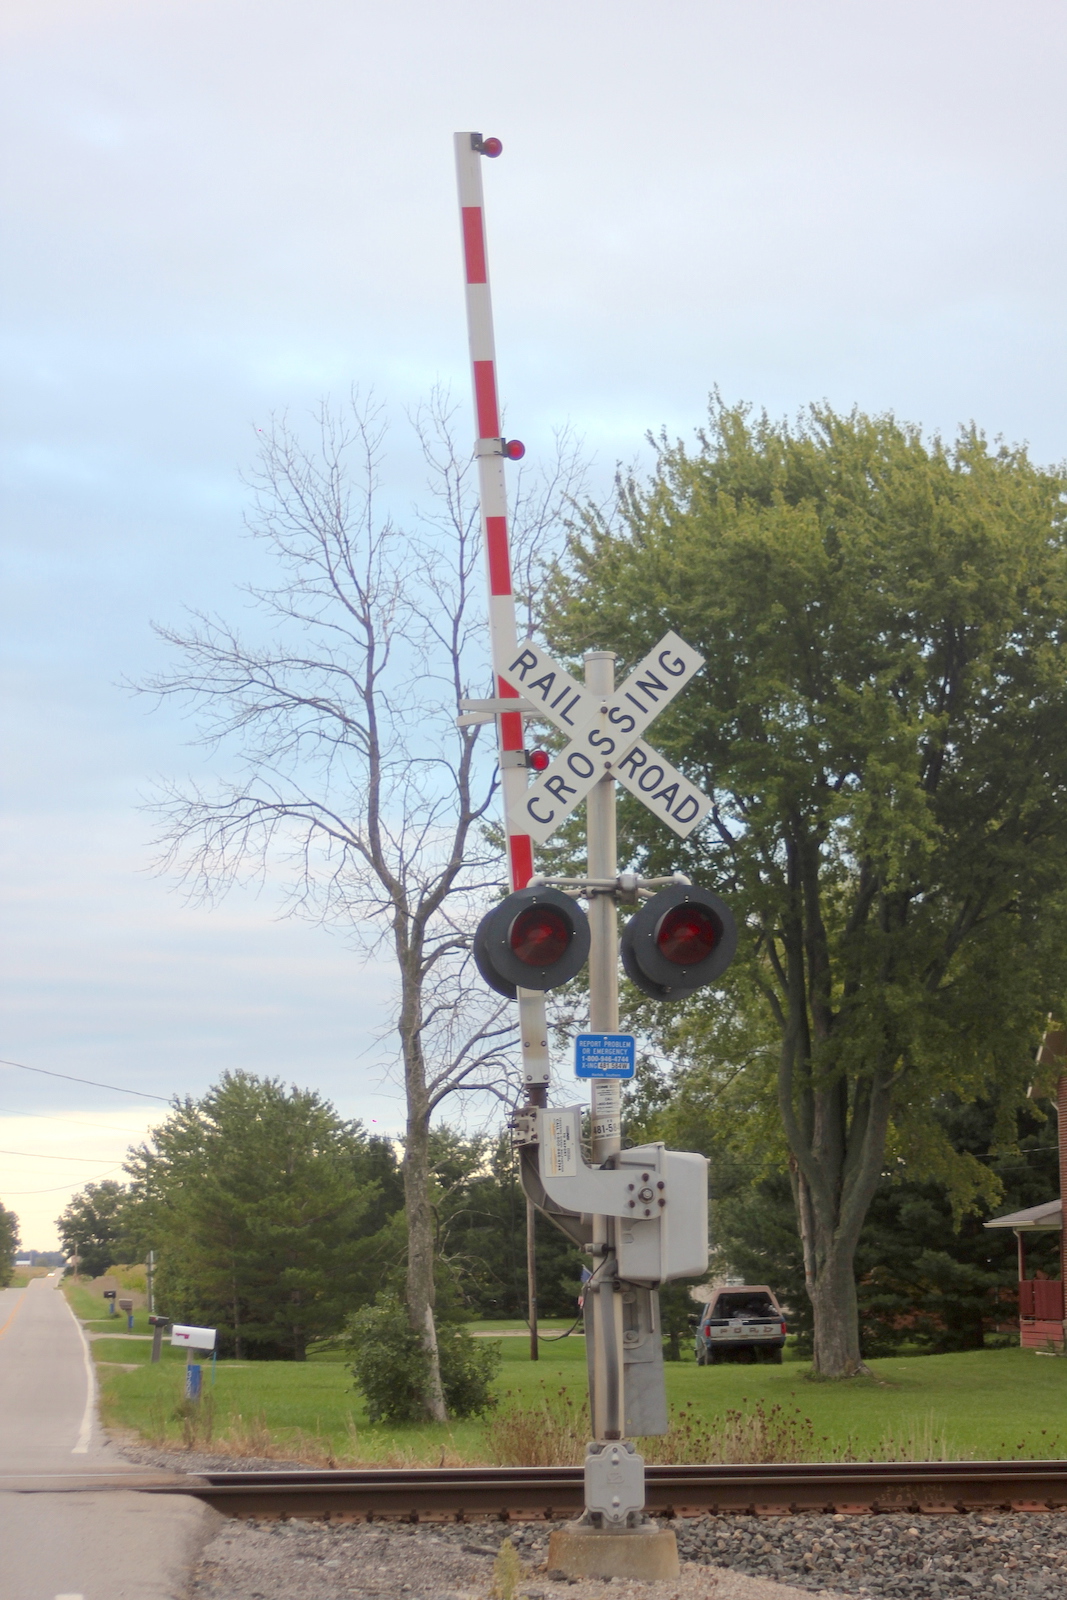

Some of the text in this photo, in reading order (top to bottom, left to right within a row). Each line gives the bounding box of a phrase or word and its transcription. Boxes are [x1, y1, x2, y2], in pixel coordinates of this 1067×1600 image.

[508, 648, 582, 727] RAIL
[526, 650, 686, 824] CROSSING
[617, 746, 700, 824] ROAD
